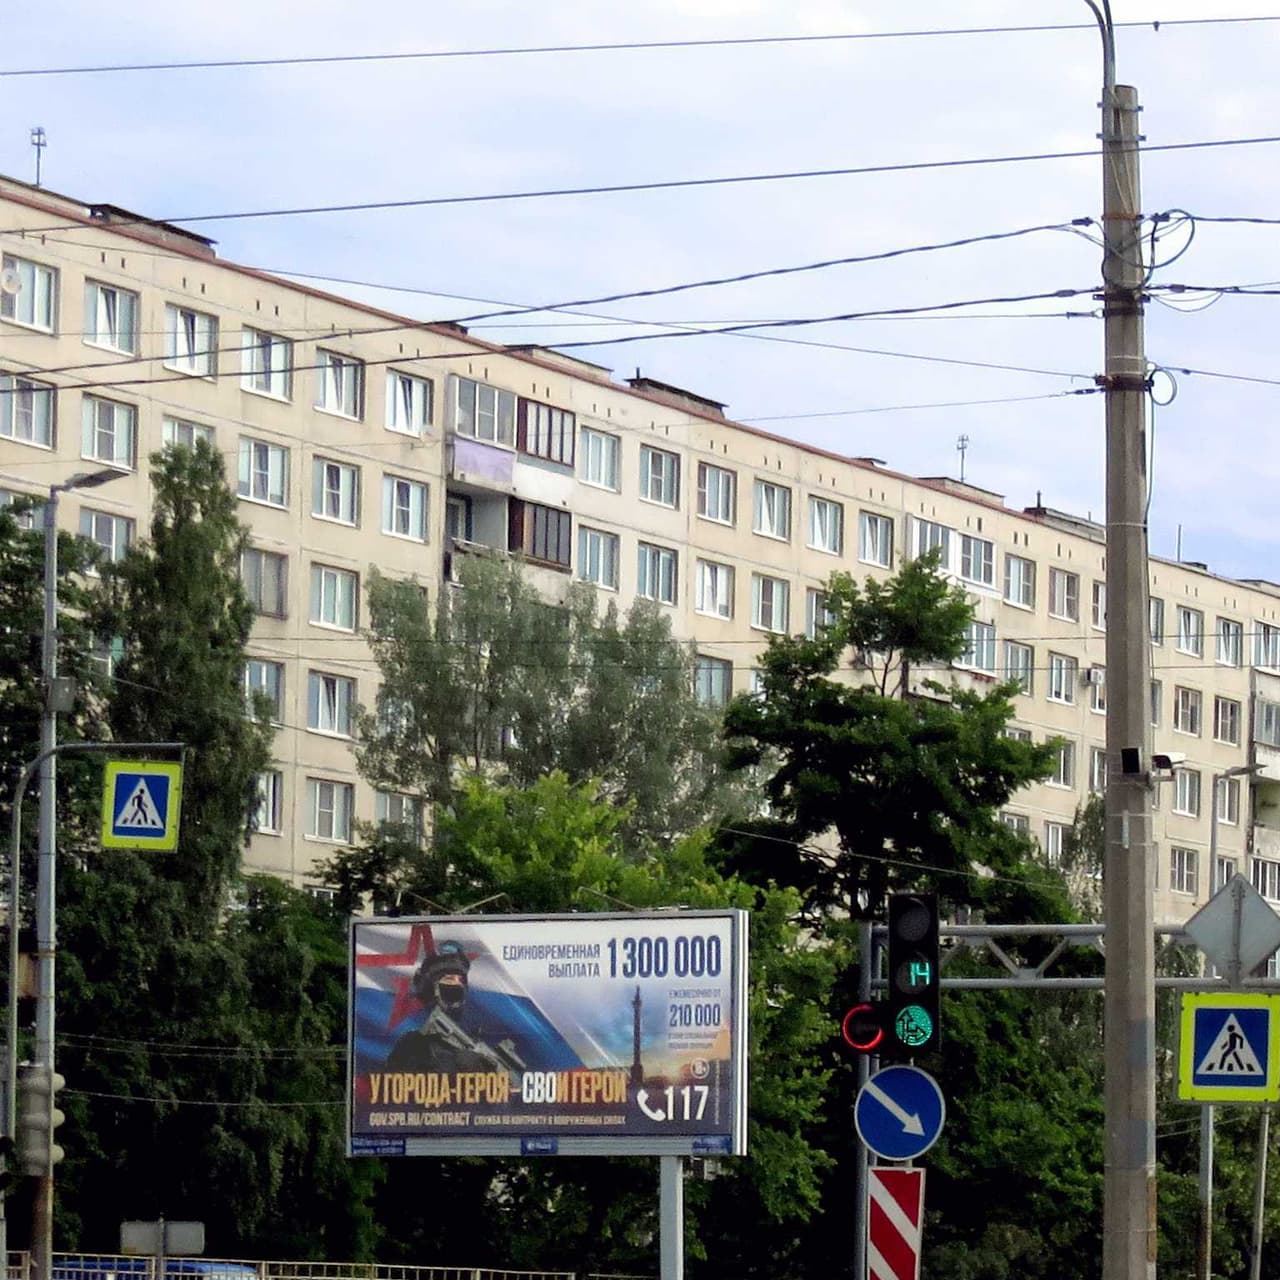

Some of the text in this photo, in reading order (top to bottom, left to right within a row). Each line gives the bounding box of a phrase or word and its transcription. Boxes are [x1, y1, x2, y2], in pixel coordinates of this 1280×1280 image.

[503, 944, 600, 961] ЕДИНОВРЕМЕННАЯ
[607, 935, 721, 978] 1 300 000
[549, 963, 600, 978] ВЫПЛАТА
[911, 962, 930, 986] 14
[670, 1003, 721, 1027] 210 000
[370, 1073, 381, 1104] У
[383, 1071, 509, 1108] ГОРОДА-ГЕРОЯ
[522, 1071, 569, 1104] СВОИ
[572, 1071, 627, 1104] ГЕРОИ
[664, 1086, 710, 1121] 117
